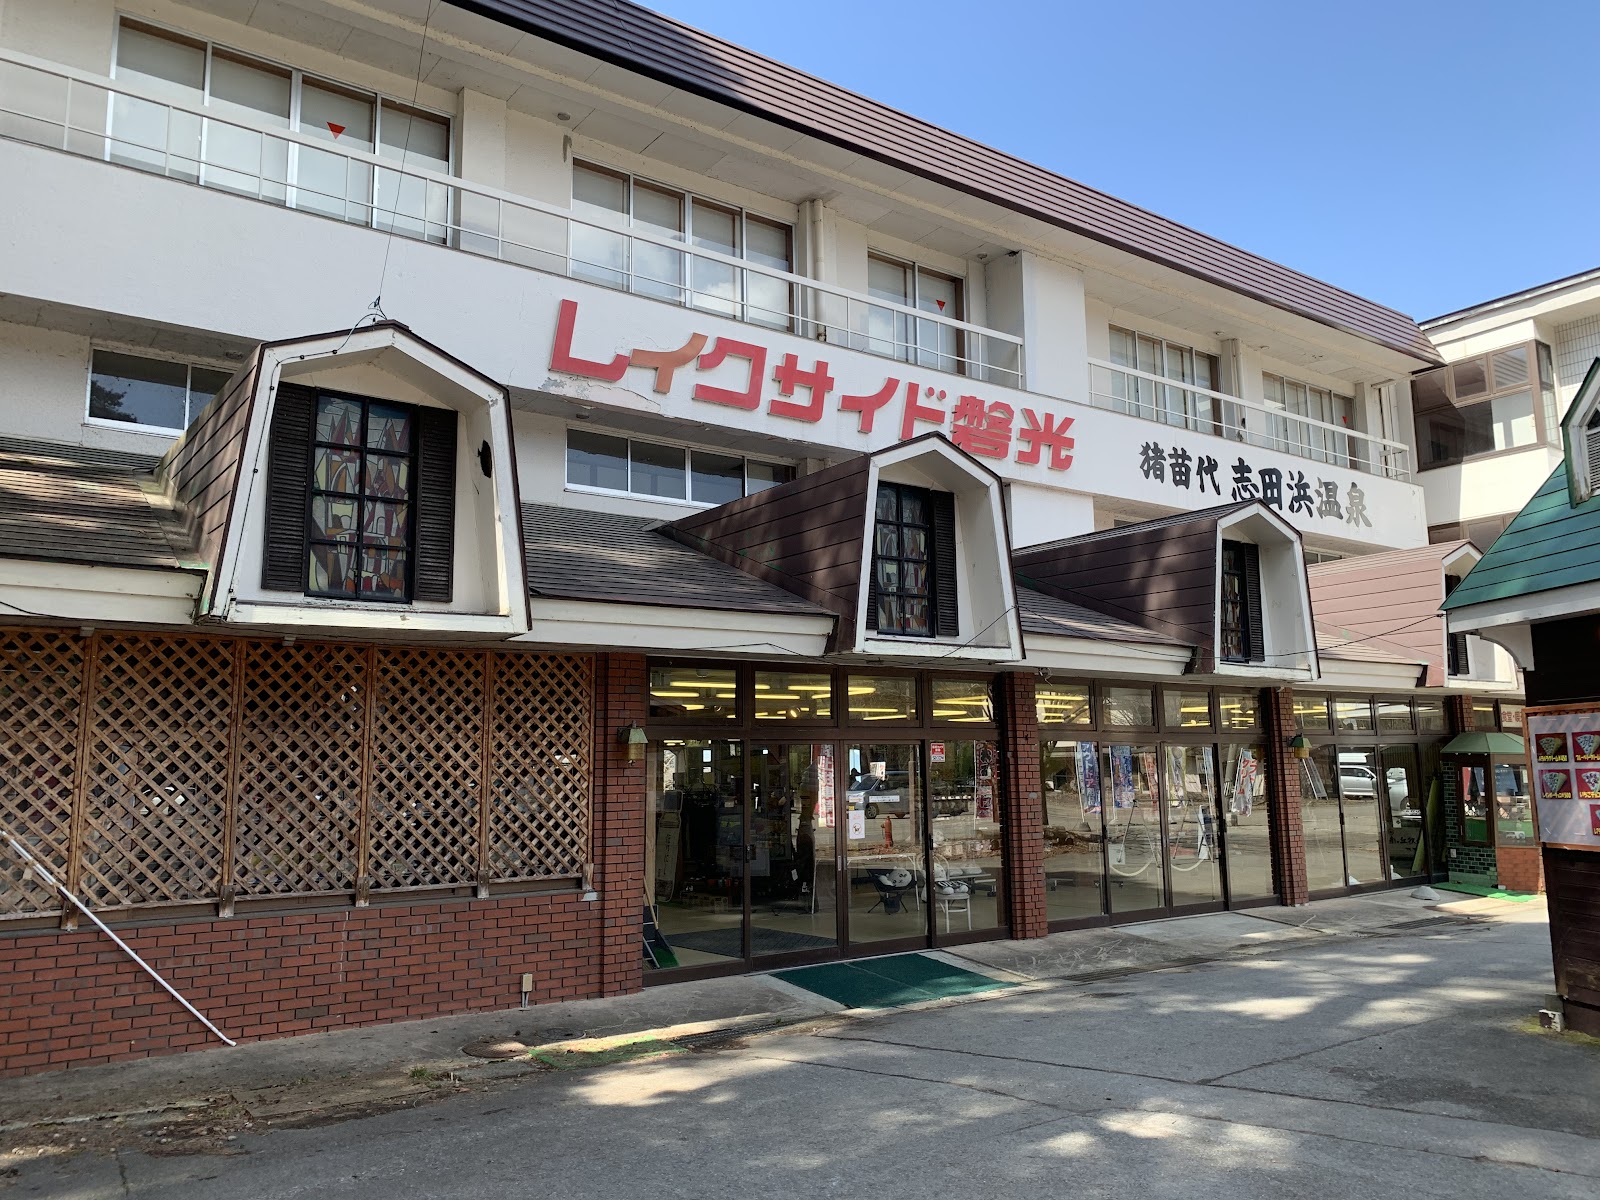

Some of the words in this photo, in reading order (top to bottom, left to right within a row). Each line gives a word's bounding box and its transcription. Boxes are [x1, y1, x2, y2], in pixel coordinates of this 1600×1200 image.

[549, 299, 1075, 471] レイクサイド磐光
[1138, 441, 1221, 496] 猪苗代
[1231, 457, 1373, 528] 志田浜温泉
